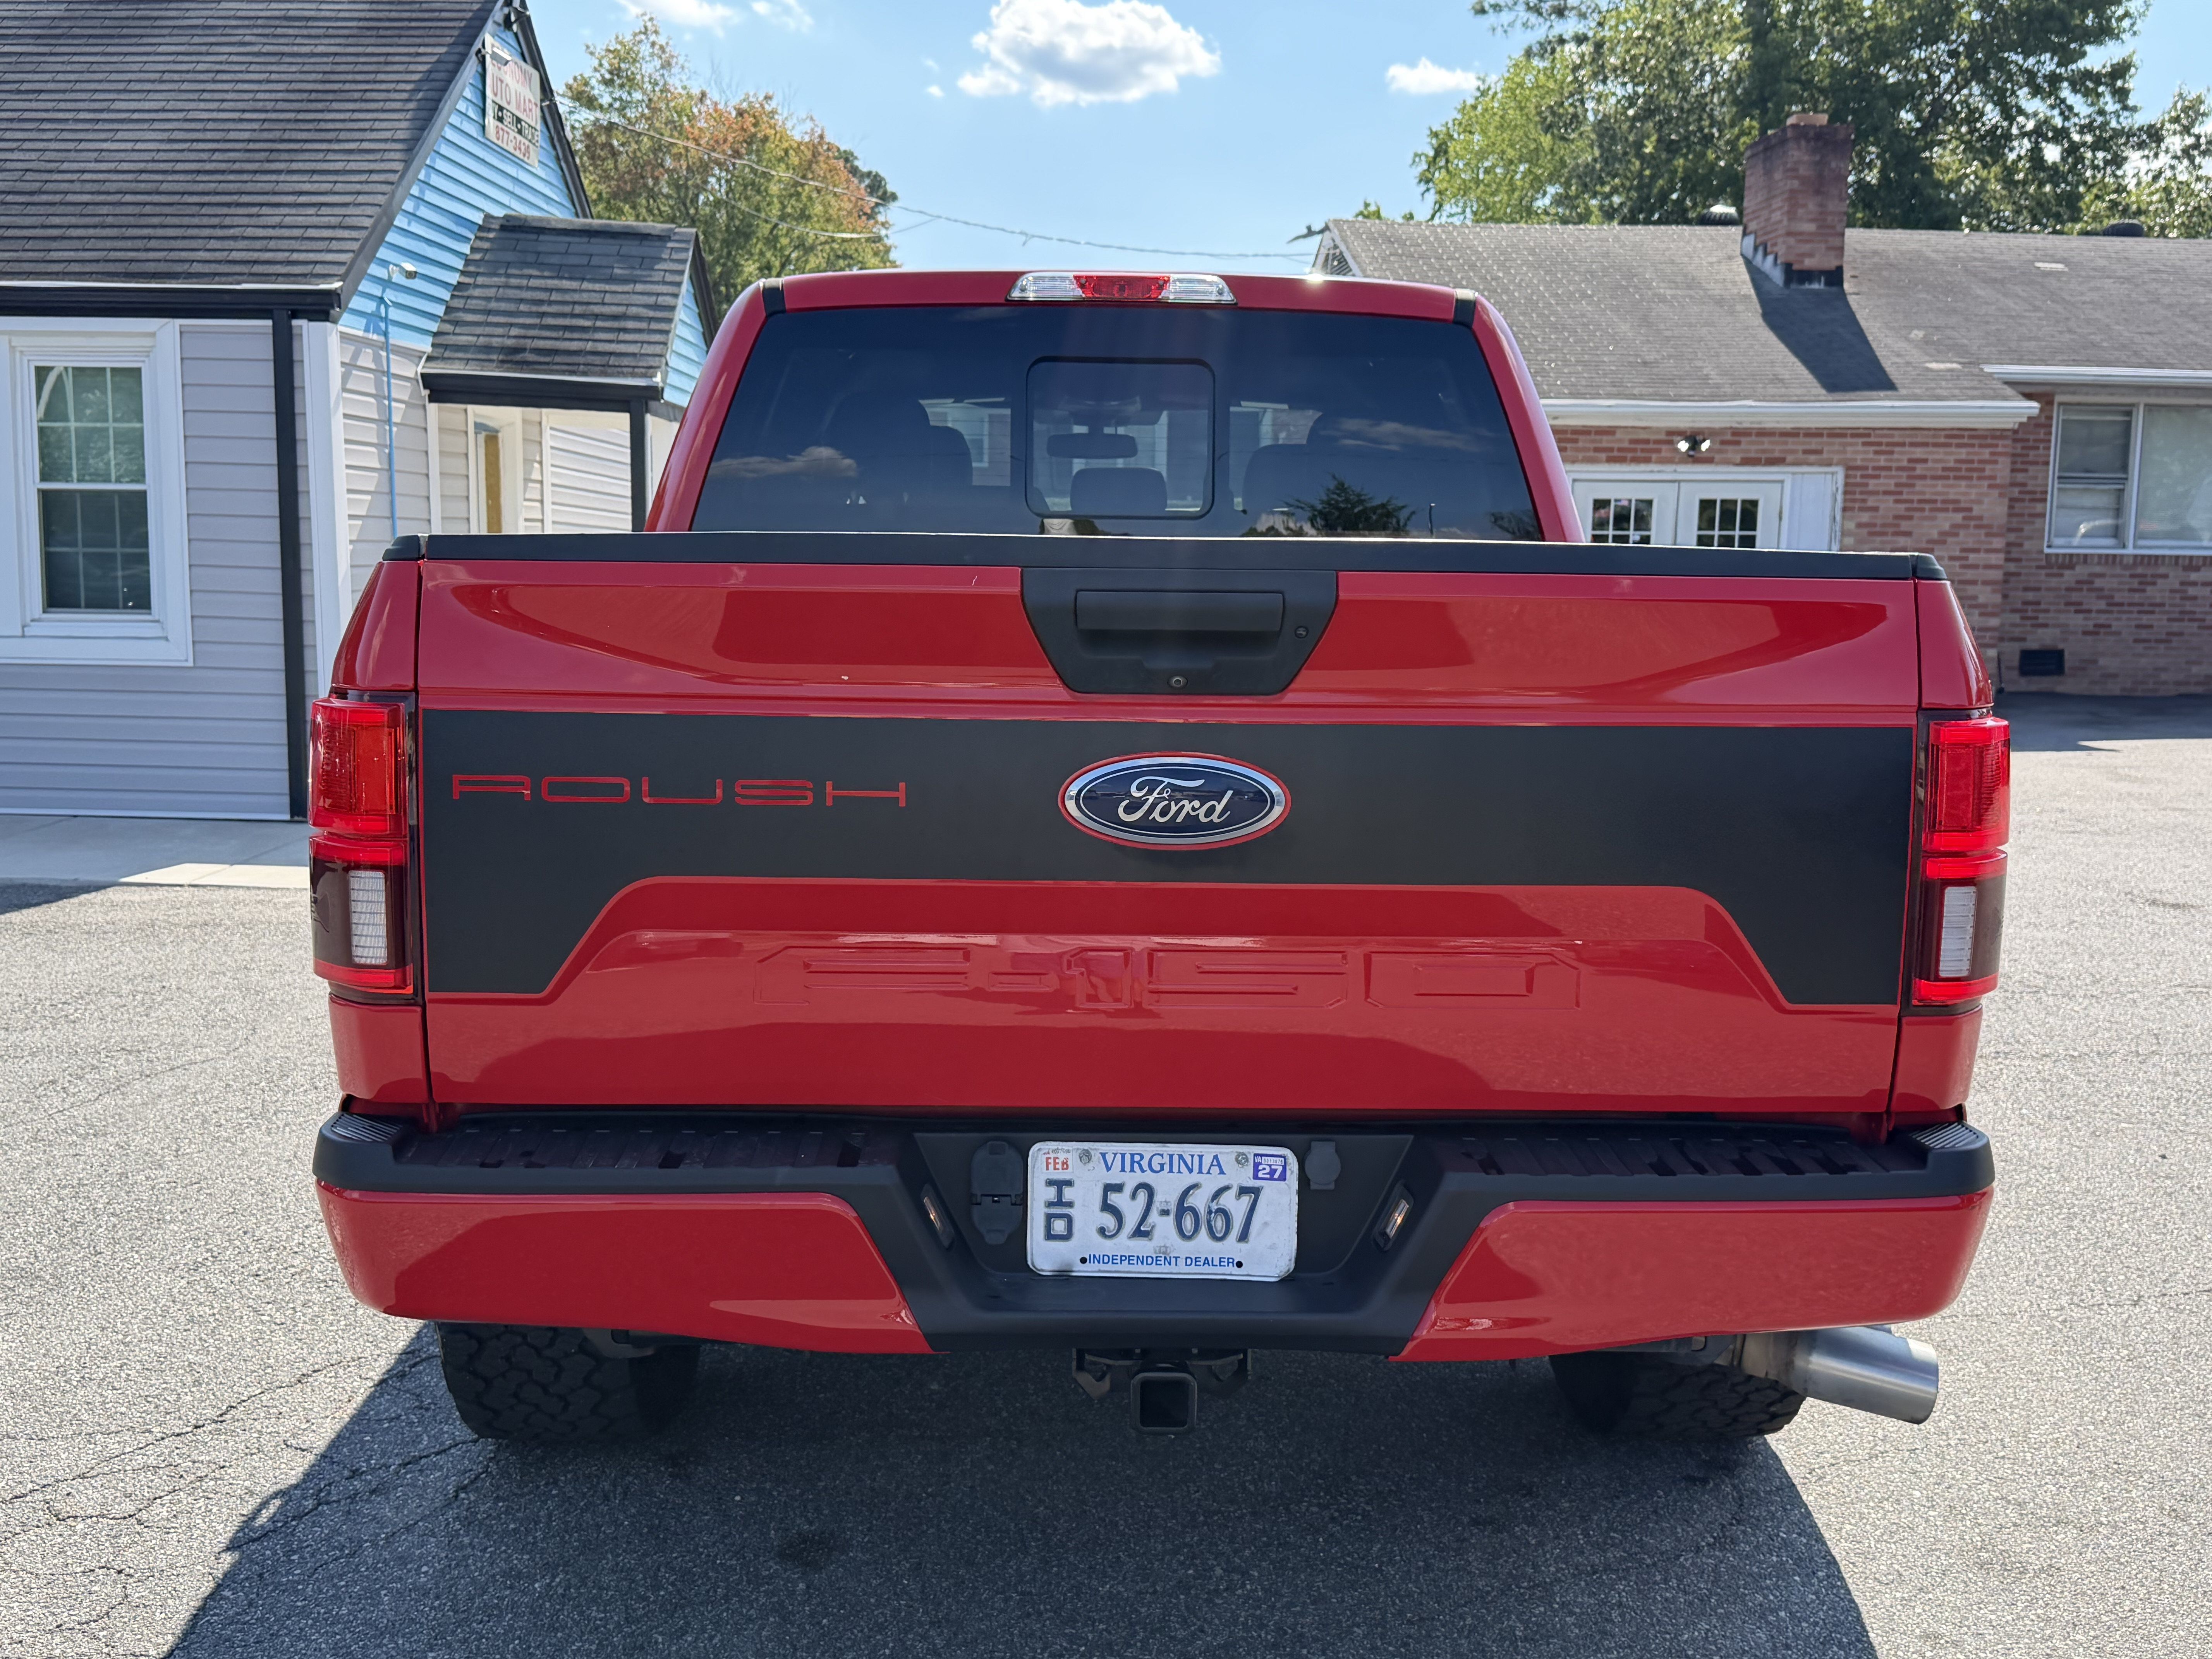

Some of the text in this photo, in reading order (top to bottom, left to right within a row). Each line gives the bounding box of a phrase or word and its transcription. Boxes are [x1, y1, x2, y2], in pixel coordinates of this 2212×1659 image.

[515, 89, 539, 126] MART
[452, 774, 906, 807] ROUSH
[1118, 776, 1234, 823] Ford
[1045, 1156, 1069, 1171] FEB
[1099, 1152, 1226, 1175] VIRGINIA
[1258, 1164, 1283, 1178] 27
[1096, 1182, 1264, 1243] 52-667
[1088, 1253, 1235, 1268] INDEPENDENT DEALER
